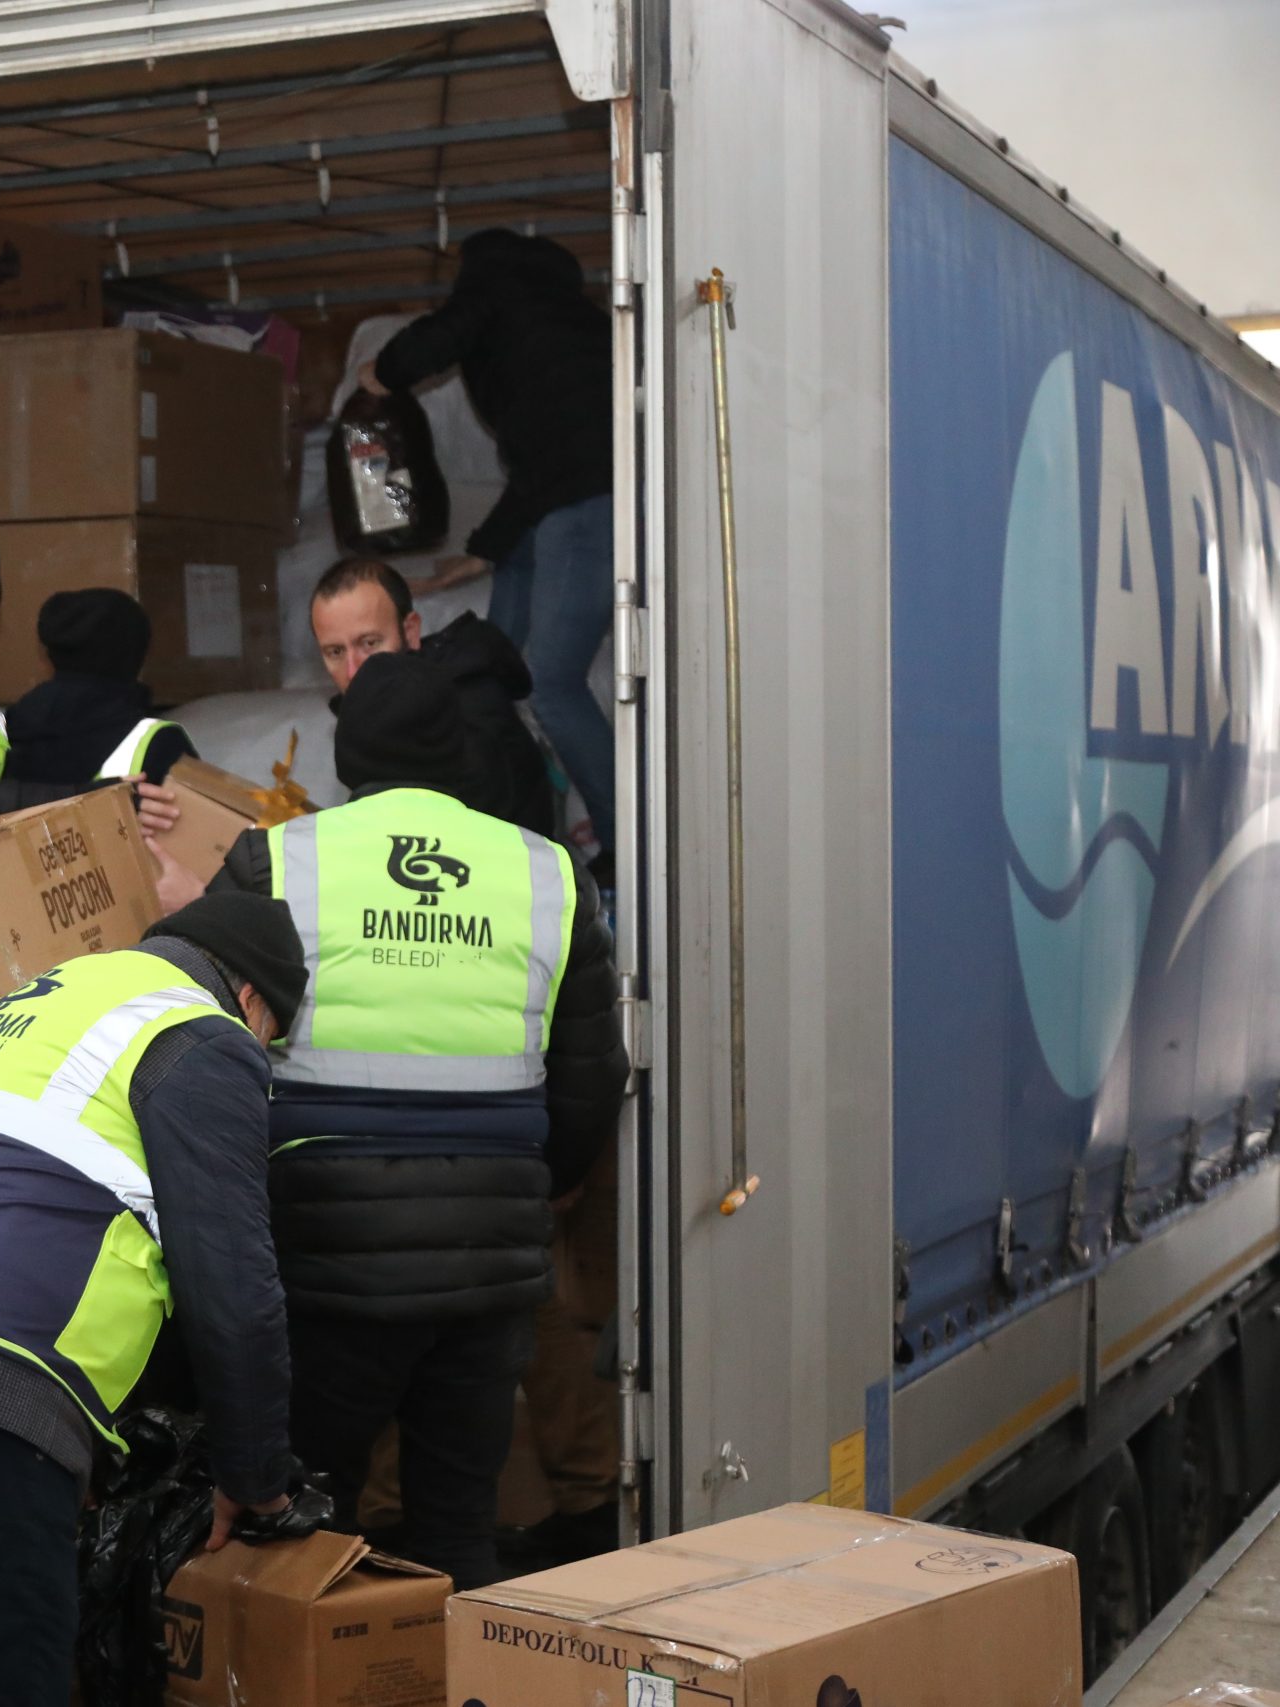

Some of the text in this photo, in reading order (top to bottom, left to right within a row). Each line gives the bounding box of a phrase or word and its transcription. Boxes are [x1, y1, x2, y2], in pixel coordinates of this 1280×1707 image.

[40, 865, 116, 934] POPCORN
[363, 908, 493, 948] BANDIRMA
[482, 1620, 627, 1669] DEPOZİTOLU
